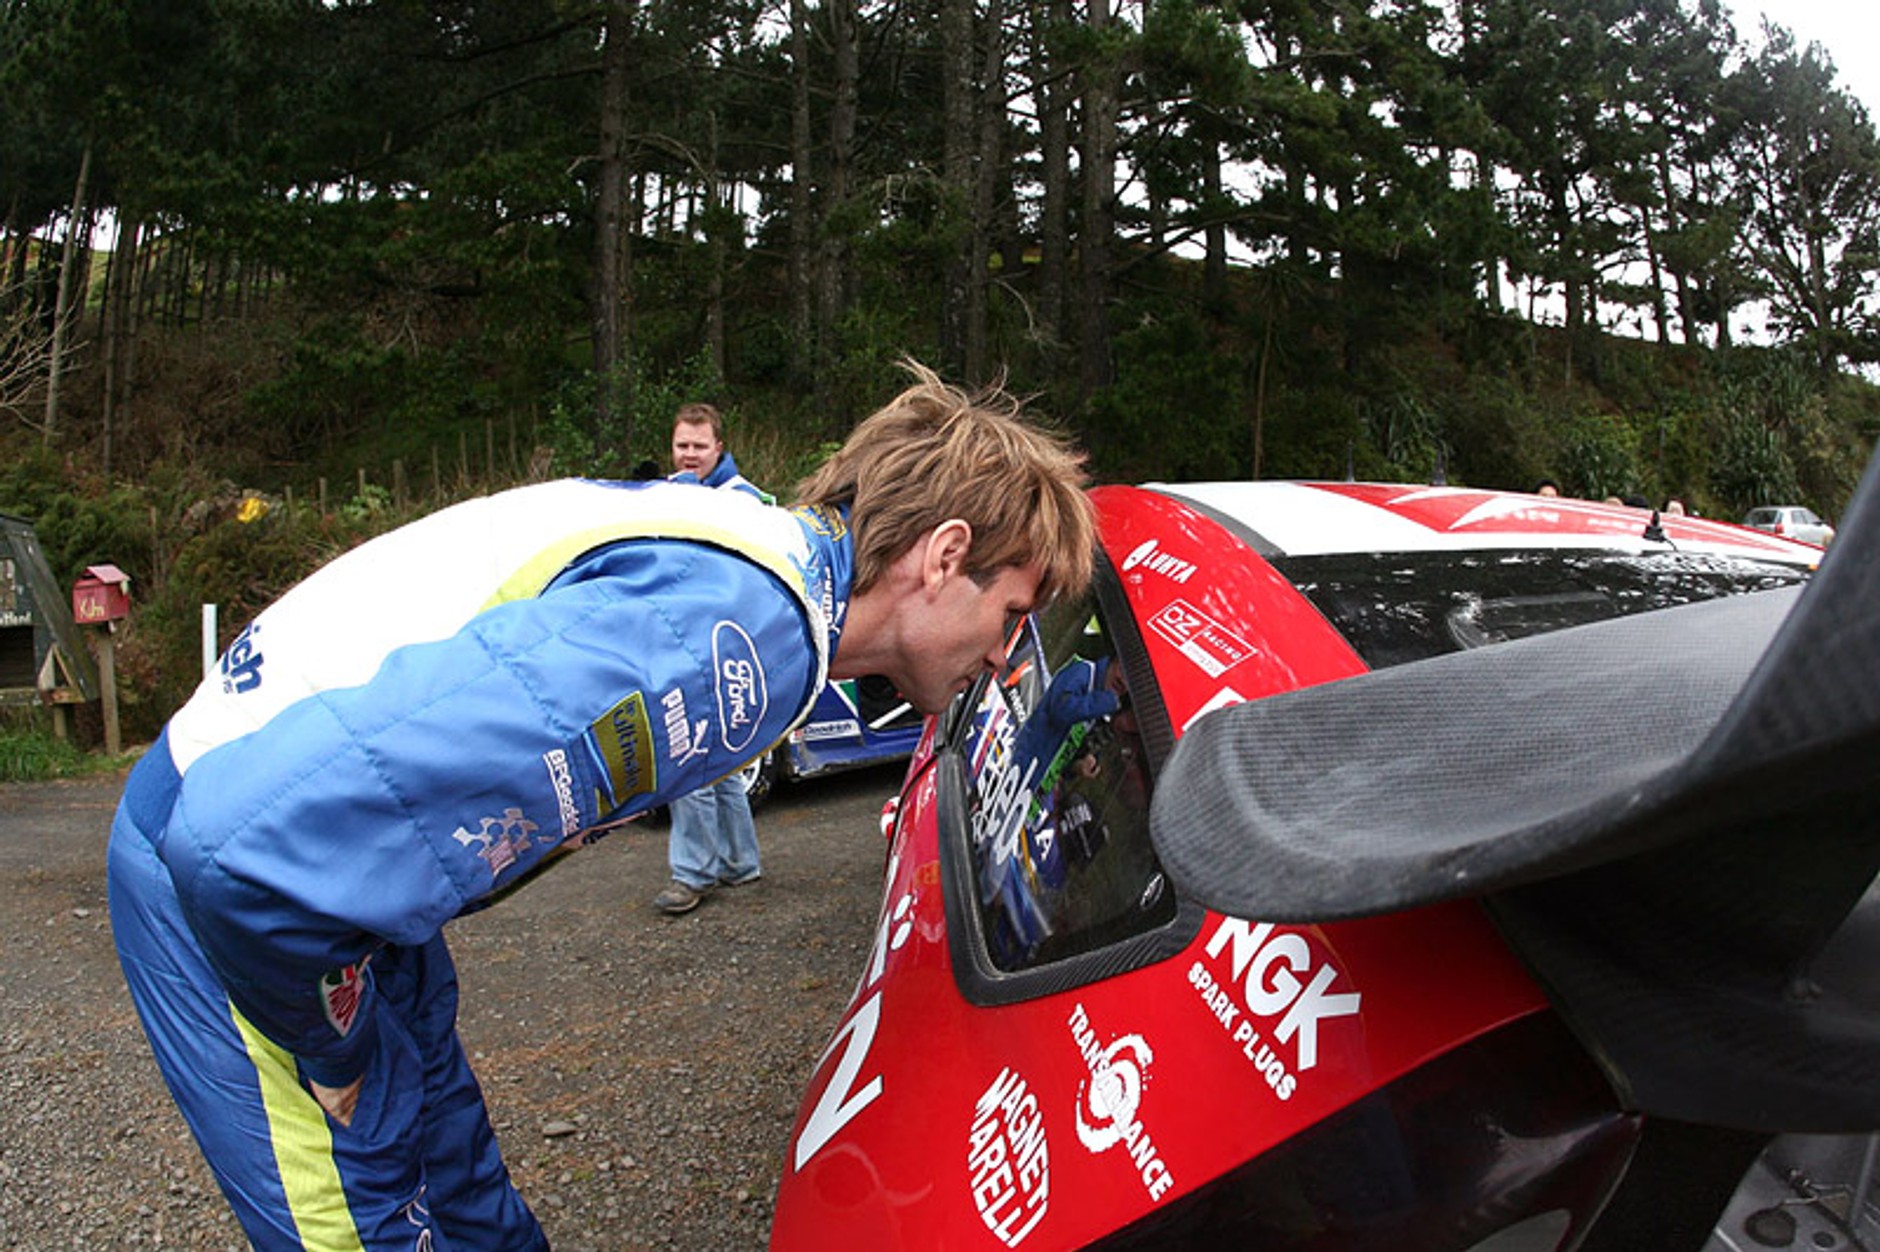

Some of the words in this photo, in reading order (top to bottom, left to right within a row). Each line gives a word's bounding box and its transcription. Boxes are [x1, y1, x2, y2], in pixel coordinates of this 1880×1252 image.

[1163, 606, 1202, 637] OZ
[1201, 627, 1243, 660] RACING
[723, 659, 758, 730] Ford
[1187, 960, 1240, 1031] SPARK
[1205, 916, 1362, 1073] NGK
[1232, 1019, 1298, 1101] PLUGS
[984, 1066, 1049, 1248] MAGNETI
